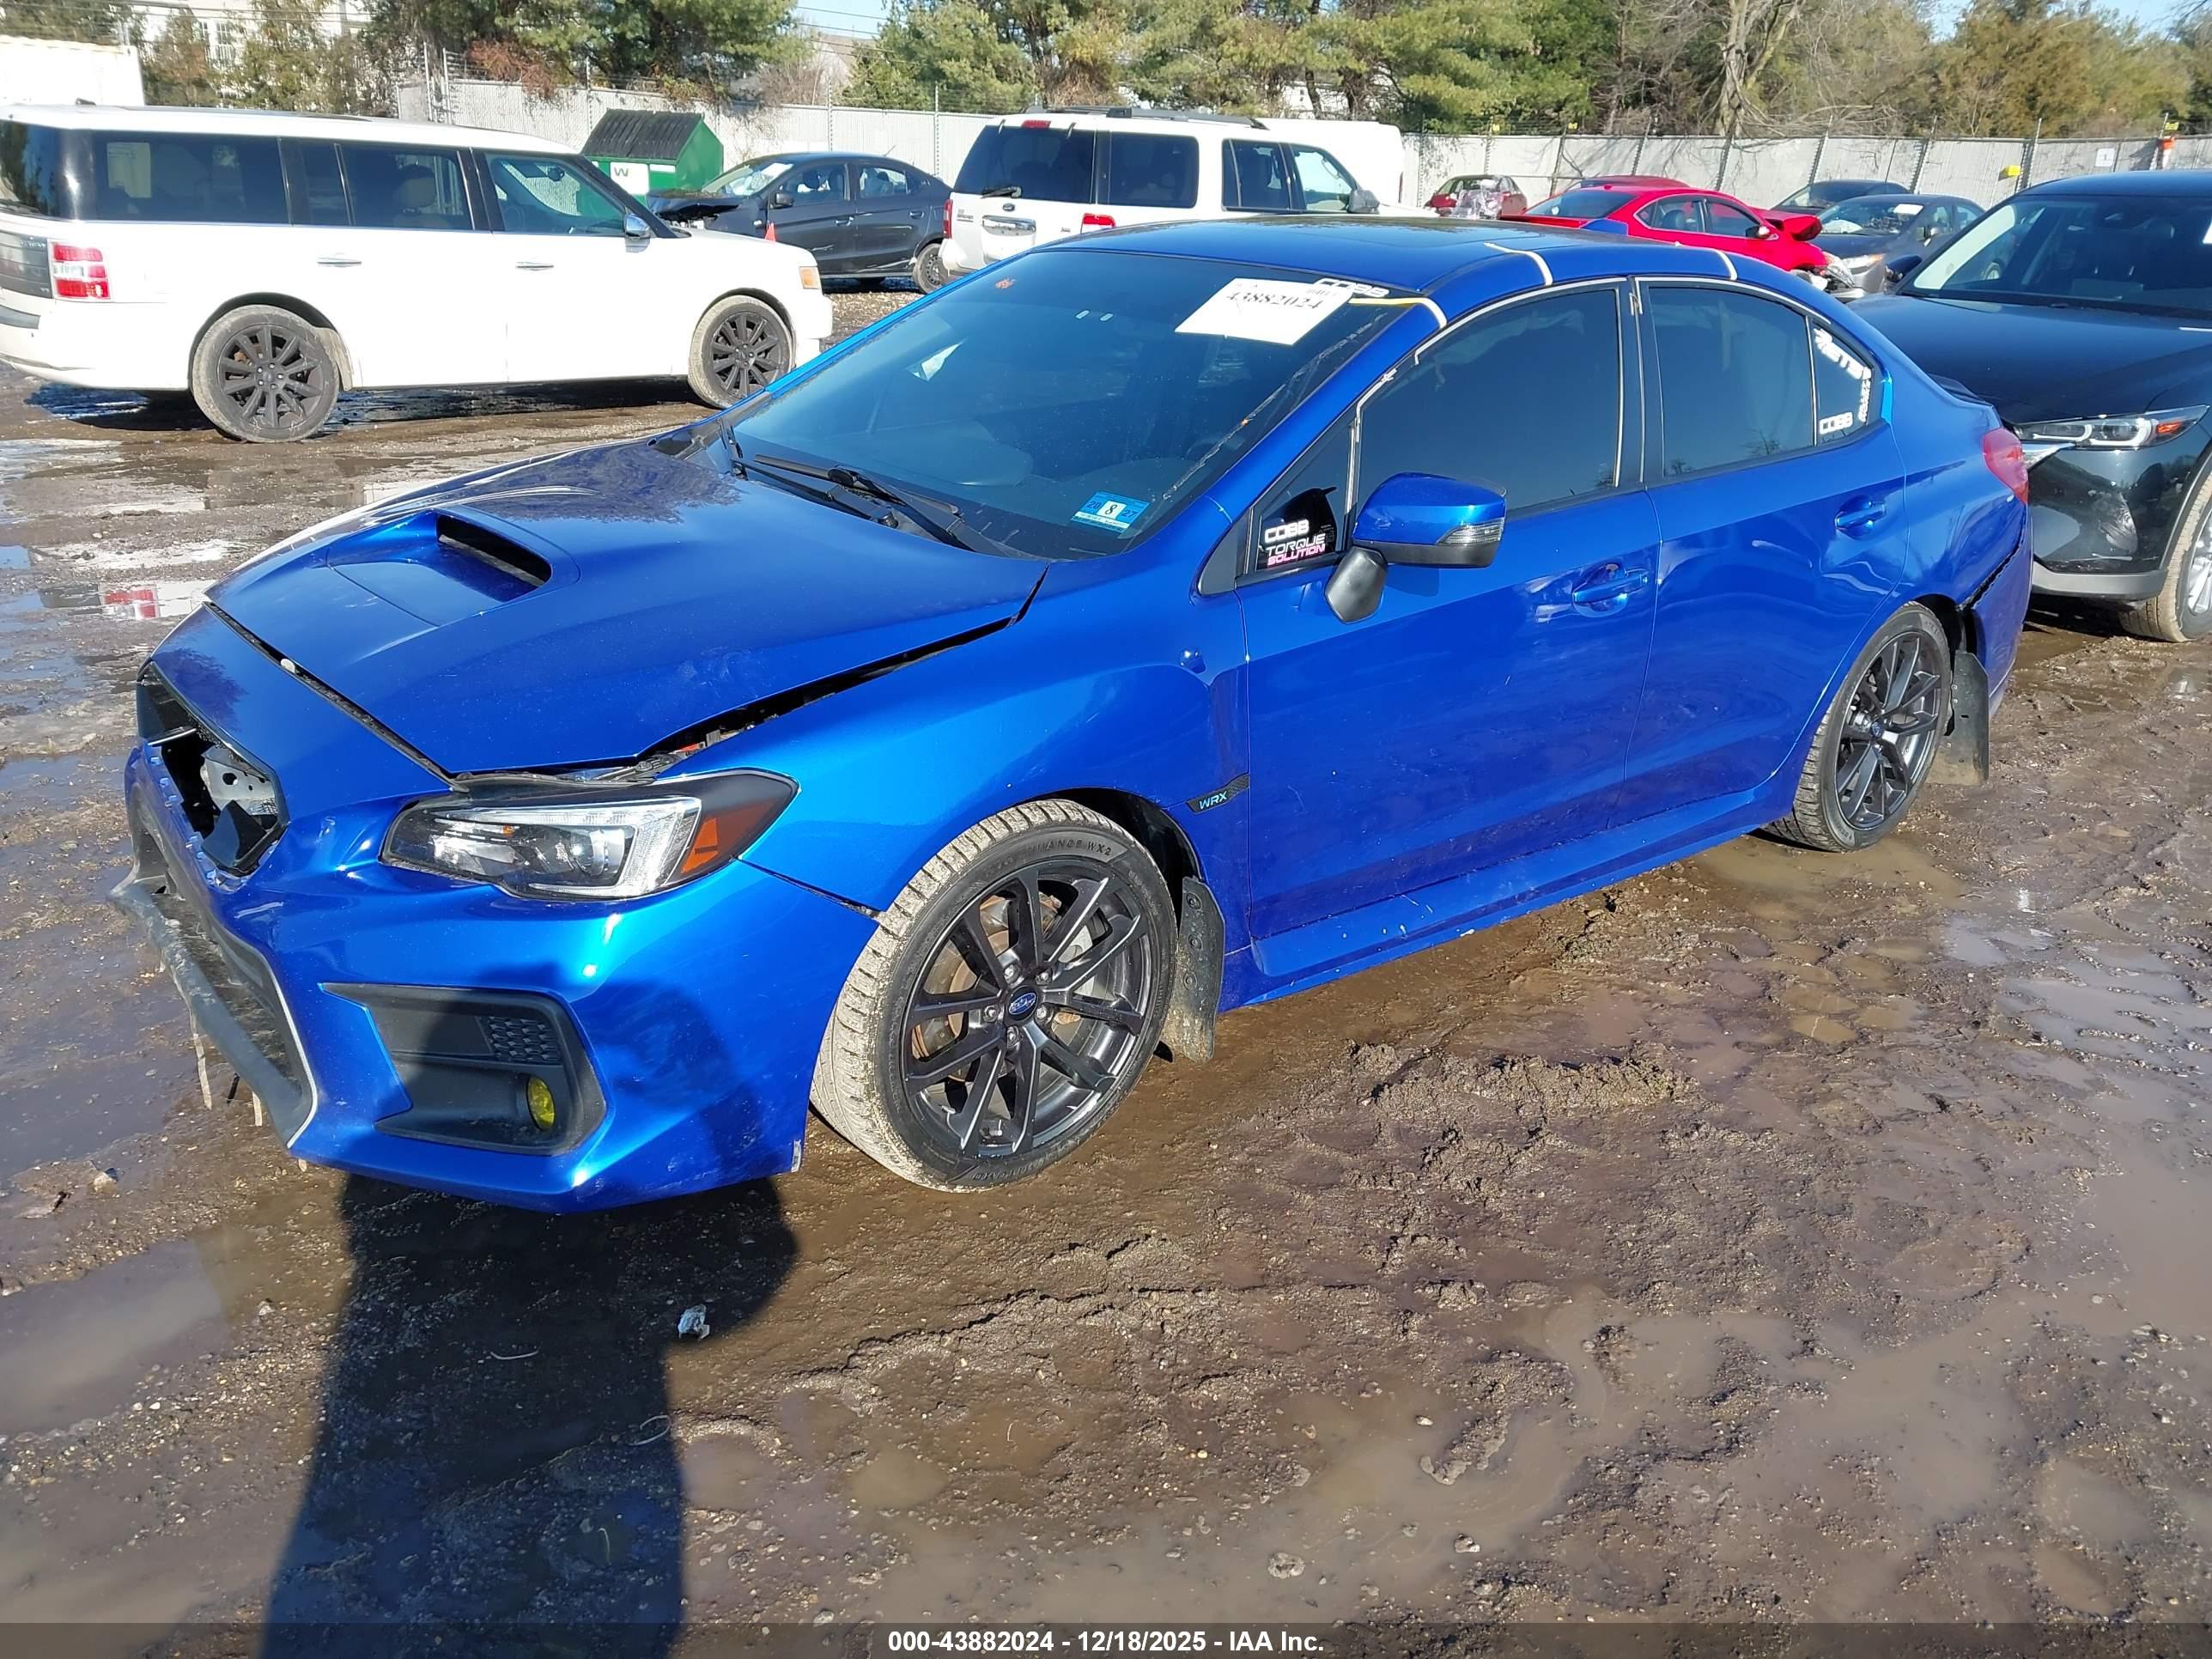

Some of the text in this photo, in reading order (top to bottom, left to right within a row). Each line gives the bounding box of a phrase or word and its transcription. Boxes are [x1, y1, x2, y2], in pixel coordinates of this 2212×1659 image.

[1226, 290, 1323, 309] 43882024
[1819, 411, 1854, 435] COBB
[1104, 503, 1118, 515] 8
[1121, 508, 1139, 518] 27
[1264, 519, 1310, 544] COBB
[1267, 533, 1326, 557] TORQUE
[1267, 543, 1326, 567] SOLUTION
[1199, 790, 1228, 810] WRX
